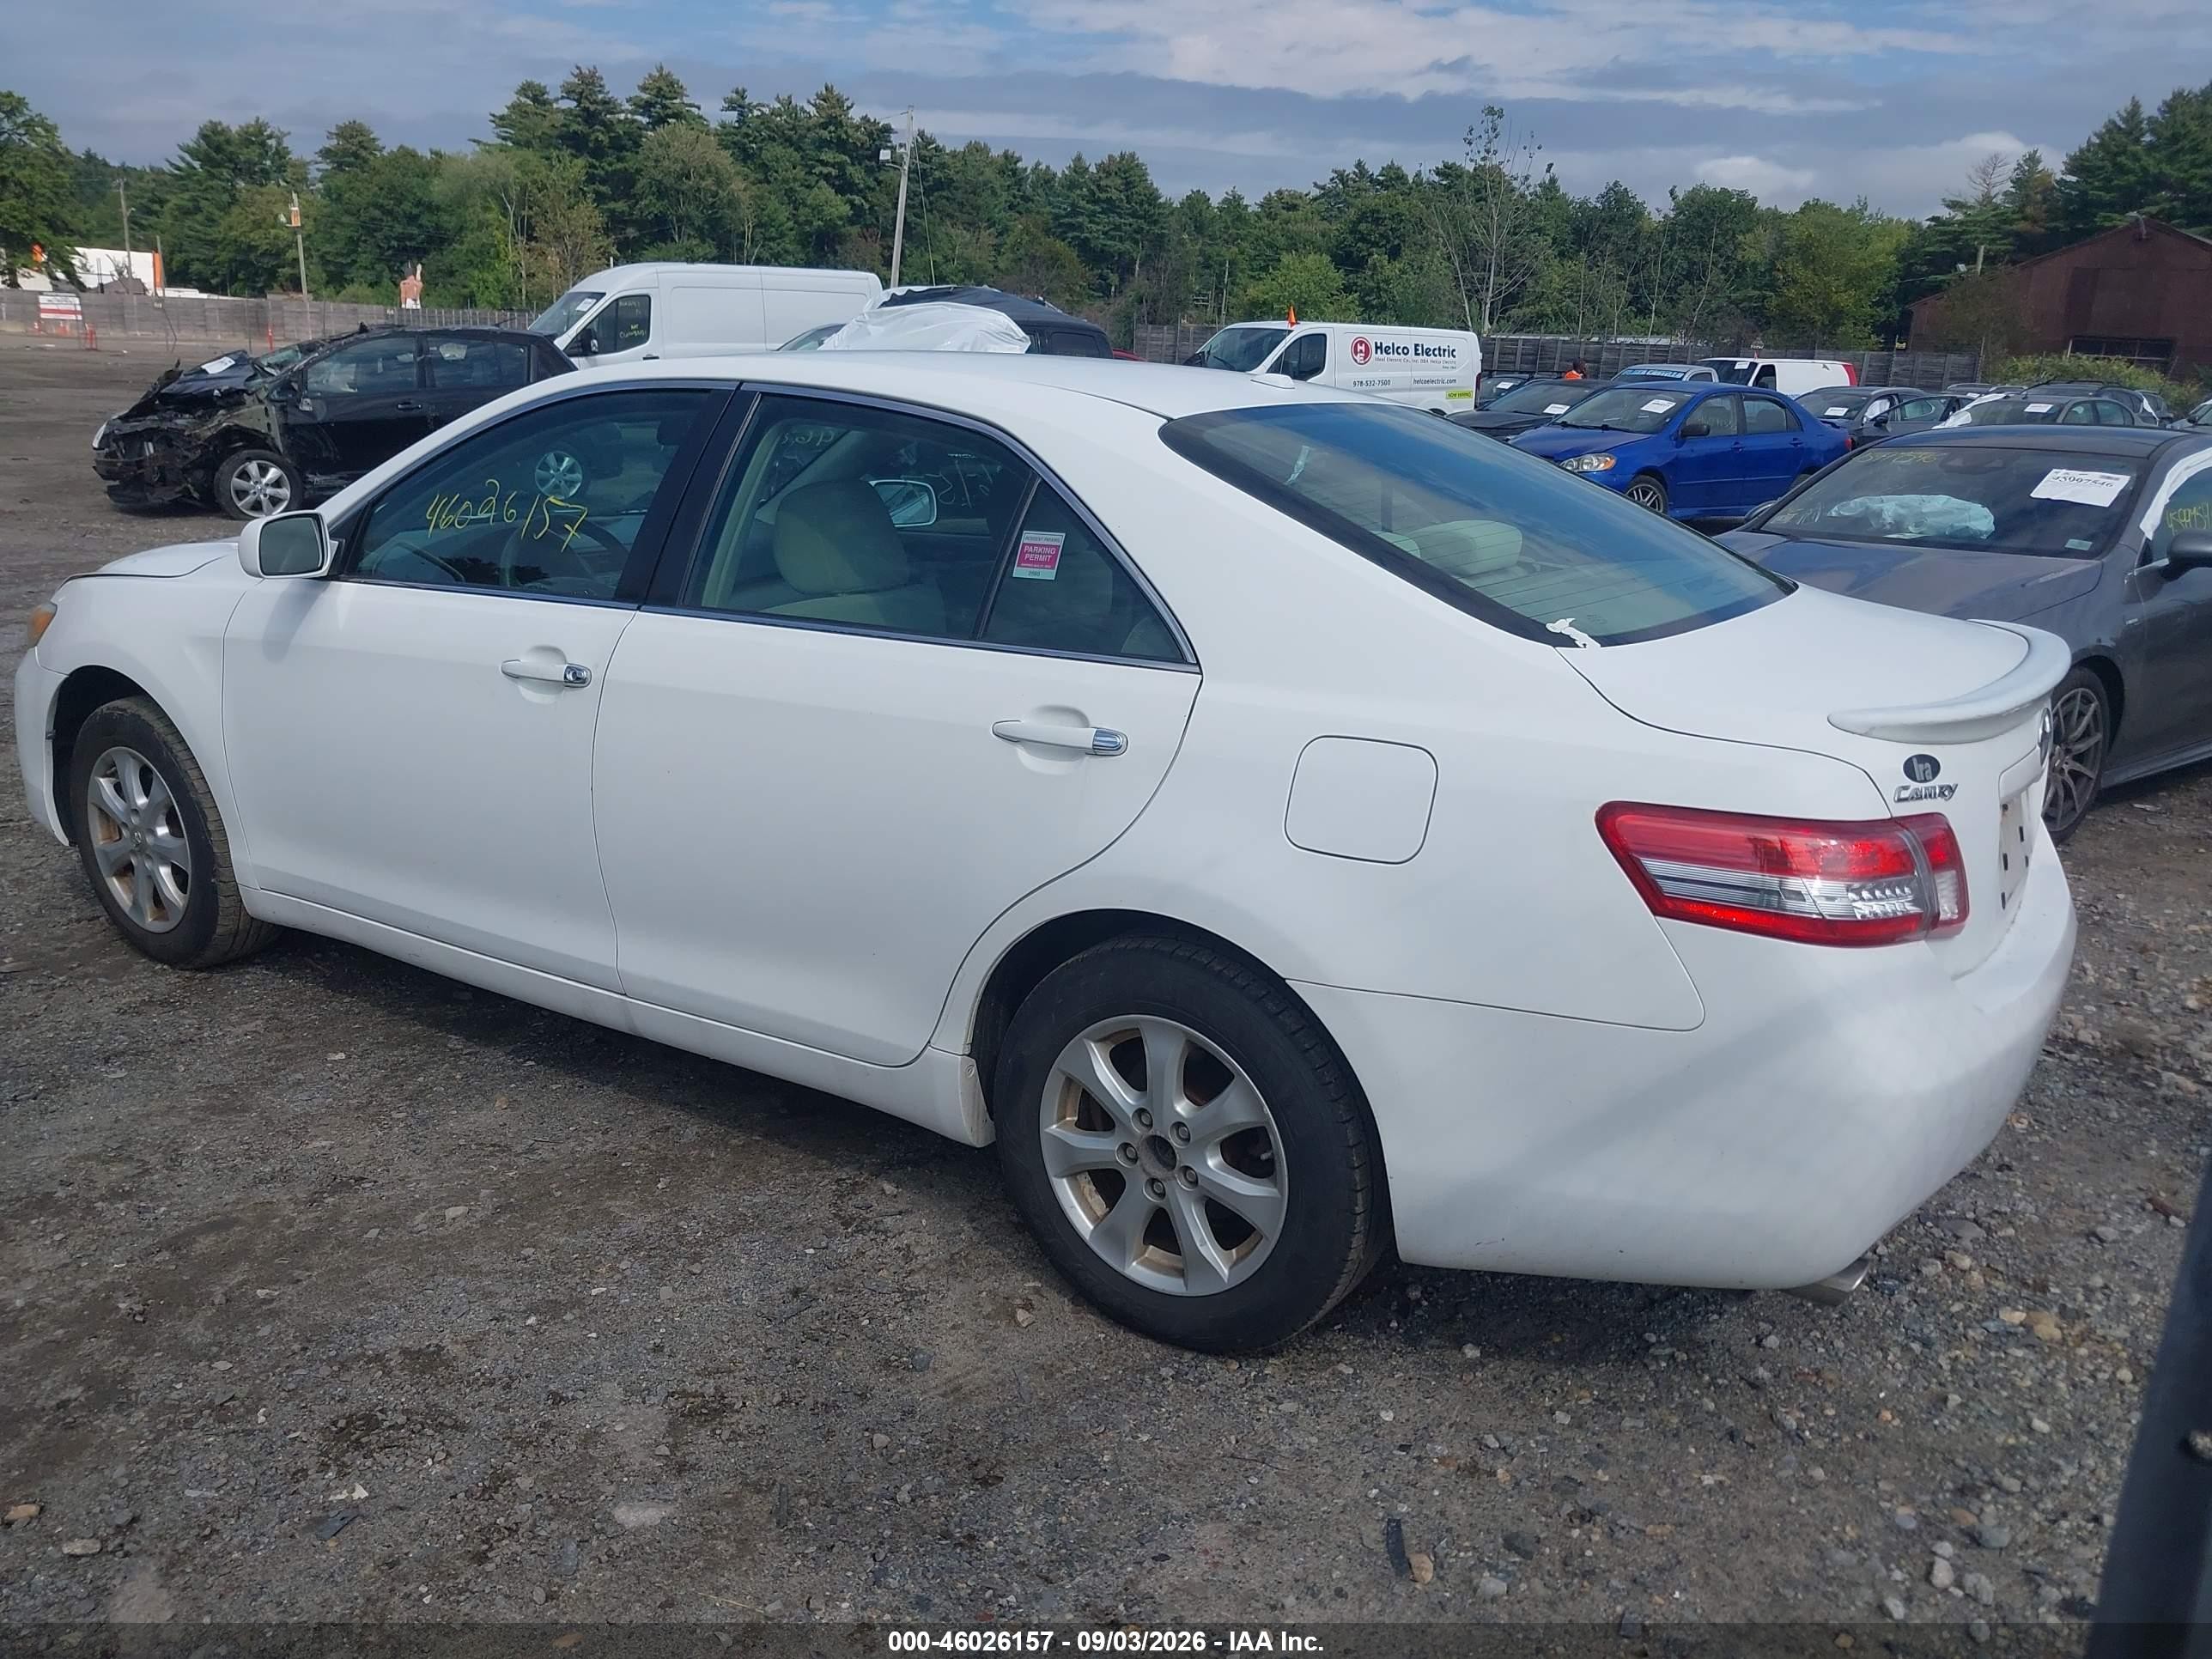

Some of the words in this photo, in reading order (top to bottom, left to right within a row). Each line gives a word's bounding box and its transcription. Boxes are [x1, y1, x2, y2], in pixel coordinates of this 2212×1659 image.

[1375, 342, 1410, 356] Helco
[1413, 343, 1456, 358] Electric
[1024, 545, 1056, 555] PARKING
[1024, 554, 1052, 562] PERMIT
